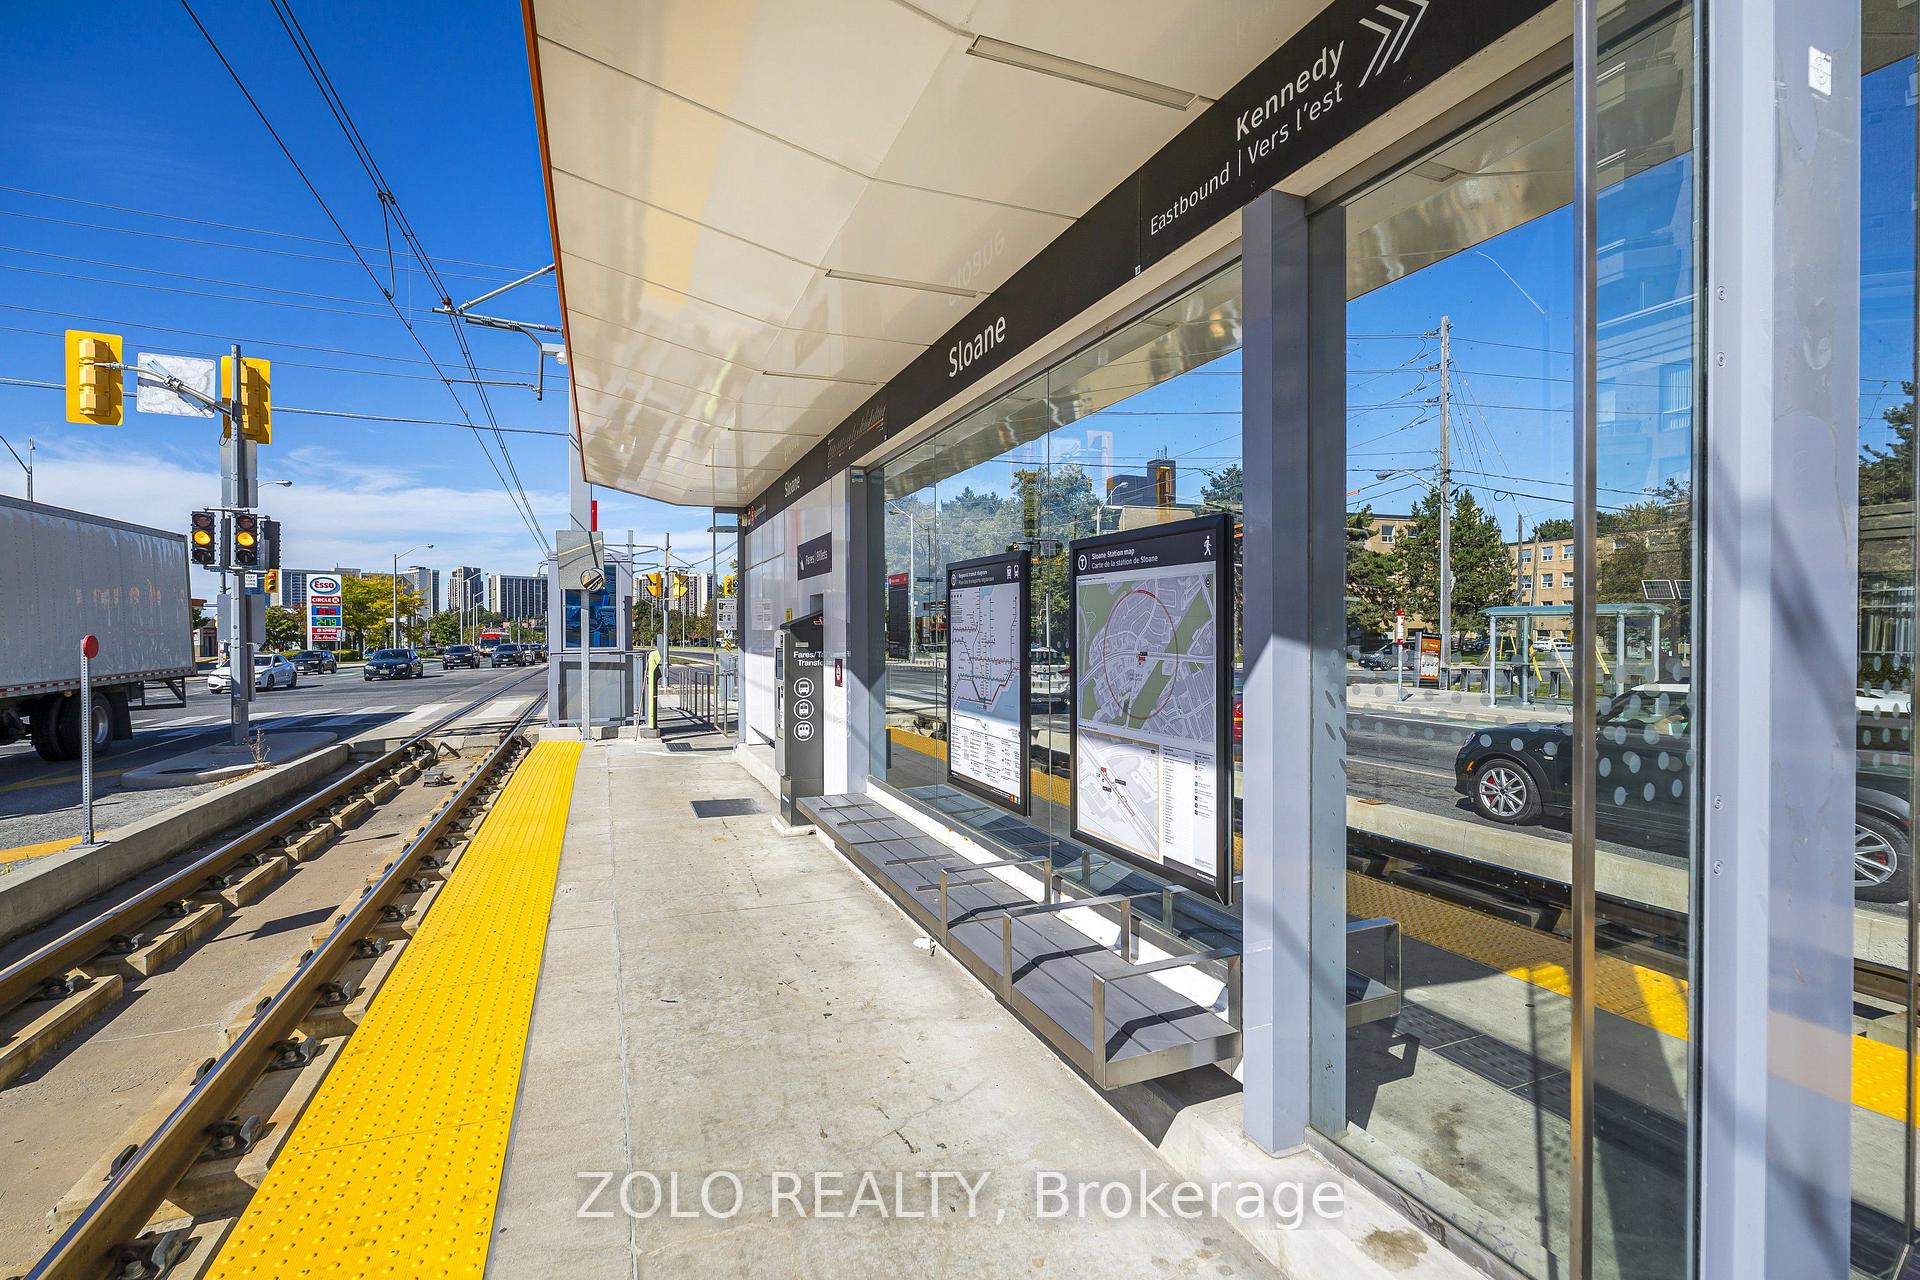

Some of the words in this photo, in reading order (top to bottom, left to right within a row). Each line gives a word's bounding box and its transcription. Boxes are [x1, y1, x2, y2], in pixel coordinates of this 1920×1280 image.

[1236, 40, 1345, 141] Kennedy
[1150, 161, 1229, 236] Eastbound
[1247, 121, 1289, 165] Vers
[949, 316, 1006, 378] Sloane
[784, 475, 800, 498] Sloane
[1091, 552, 1107, 560] Sloane
[1107, 549, 1123, 558] Station
[1124, 548, 1135, 557] map
[1104, 560, 1111, 568] de
[1116, 558, 1132, 567] station
[1140, 555, 1158, 563] Sloane
[314, 580, 335, 589] Esso
